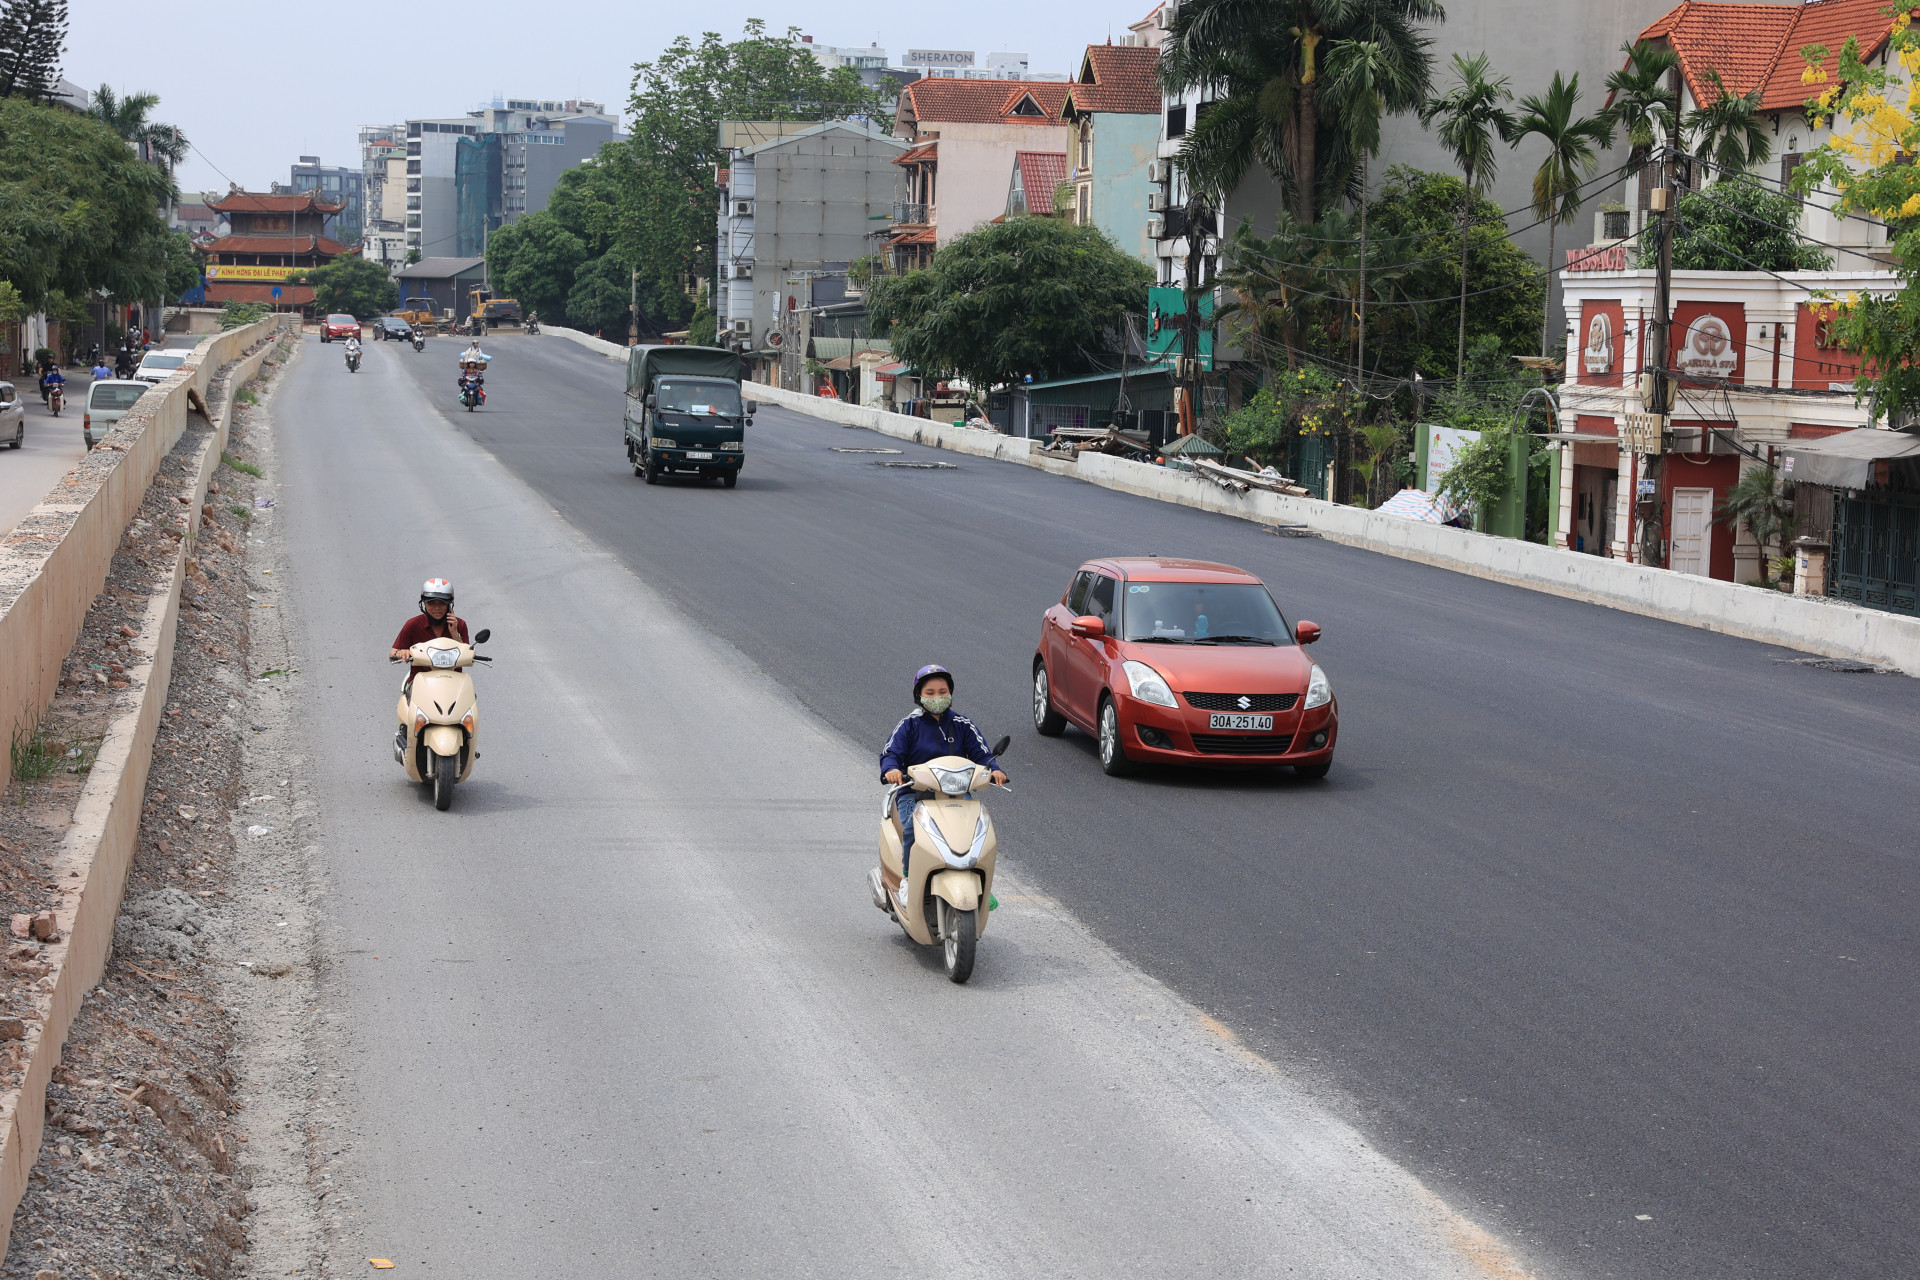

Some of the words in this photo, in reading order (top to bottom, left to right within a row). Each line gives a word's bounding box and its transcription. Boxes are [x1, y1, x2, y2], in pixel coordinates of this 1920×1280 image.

[911, 52, 973, 63] SHERATON
[1565, 247, 1627, 272] MASSAGE
[1719, 360, 1737, 369] SPA
[1211, 715, 1272, 729] 30A-251.40
